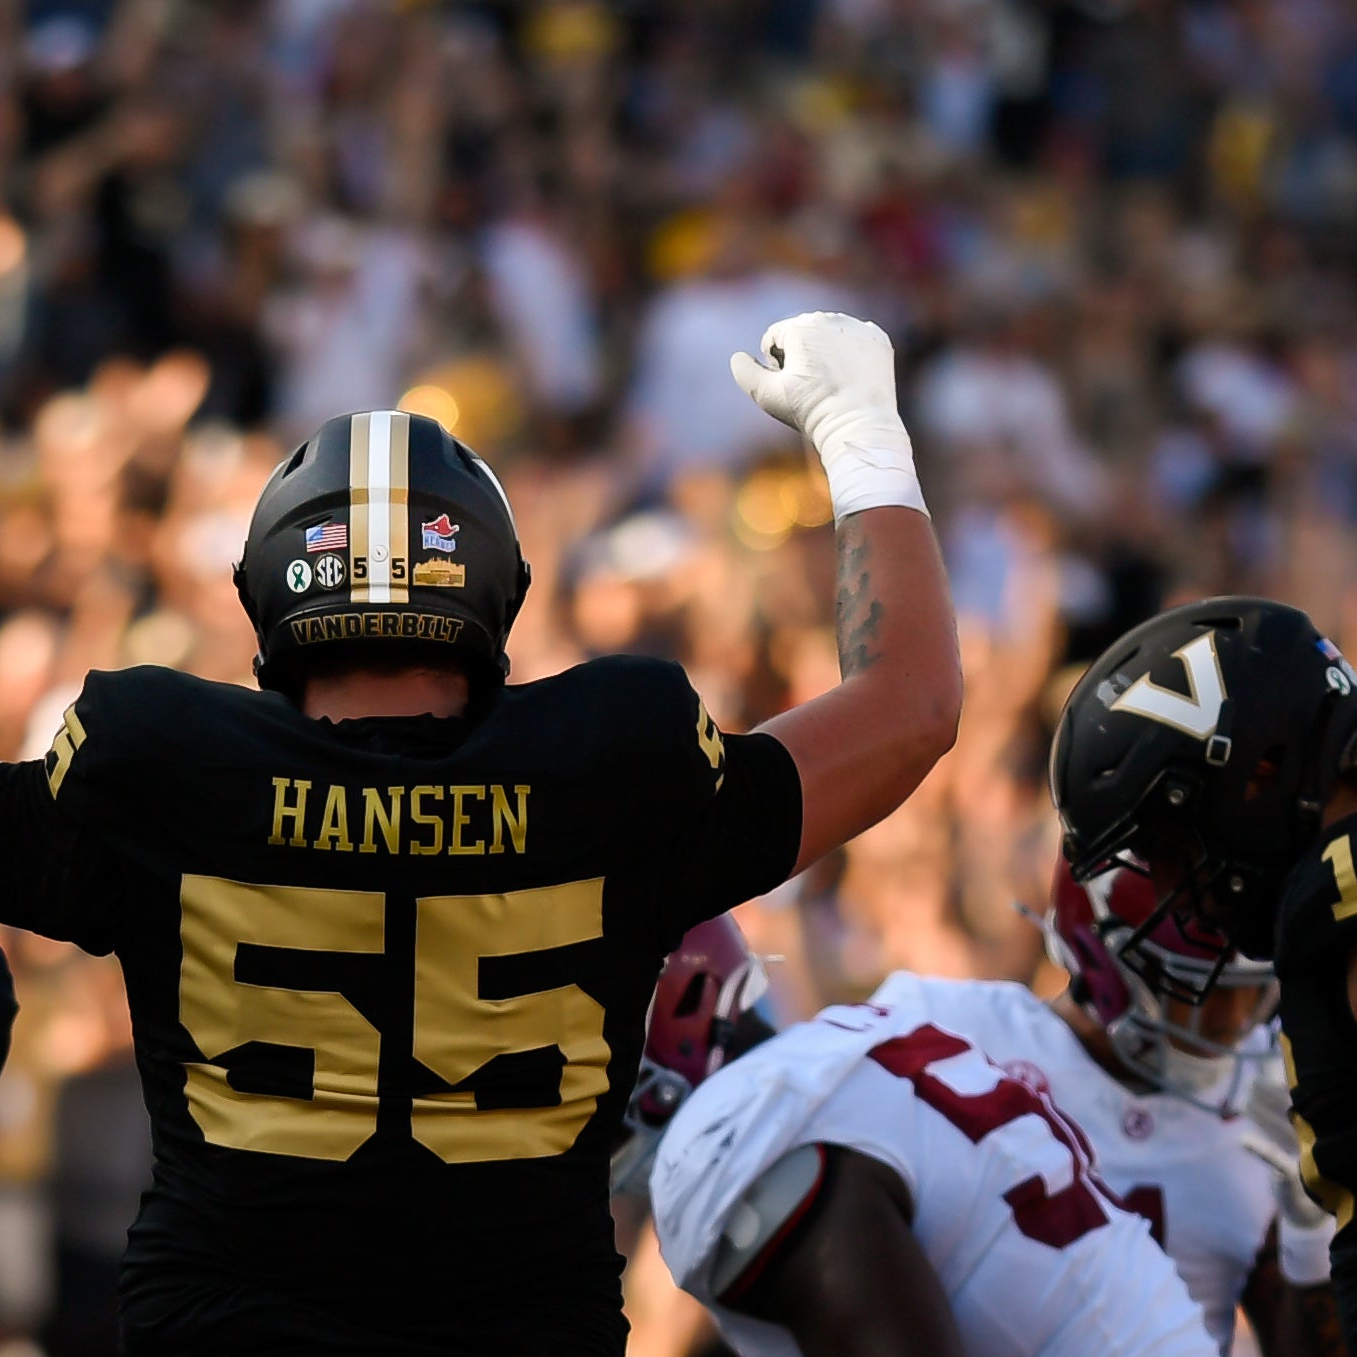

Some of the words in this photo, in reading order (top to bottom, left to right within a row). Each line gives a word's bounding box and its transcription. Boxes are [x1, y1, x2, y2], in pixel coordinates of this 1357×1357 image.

[315, 555, 345, 588] SEC
[291, 613, 464, 646] VANDERBILT
[268, 777, 531, 855] HANSEN
[179, 873, 611, 1164] 55
